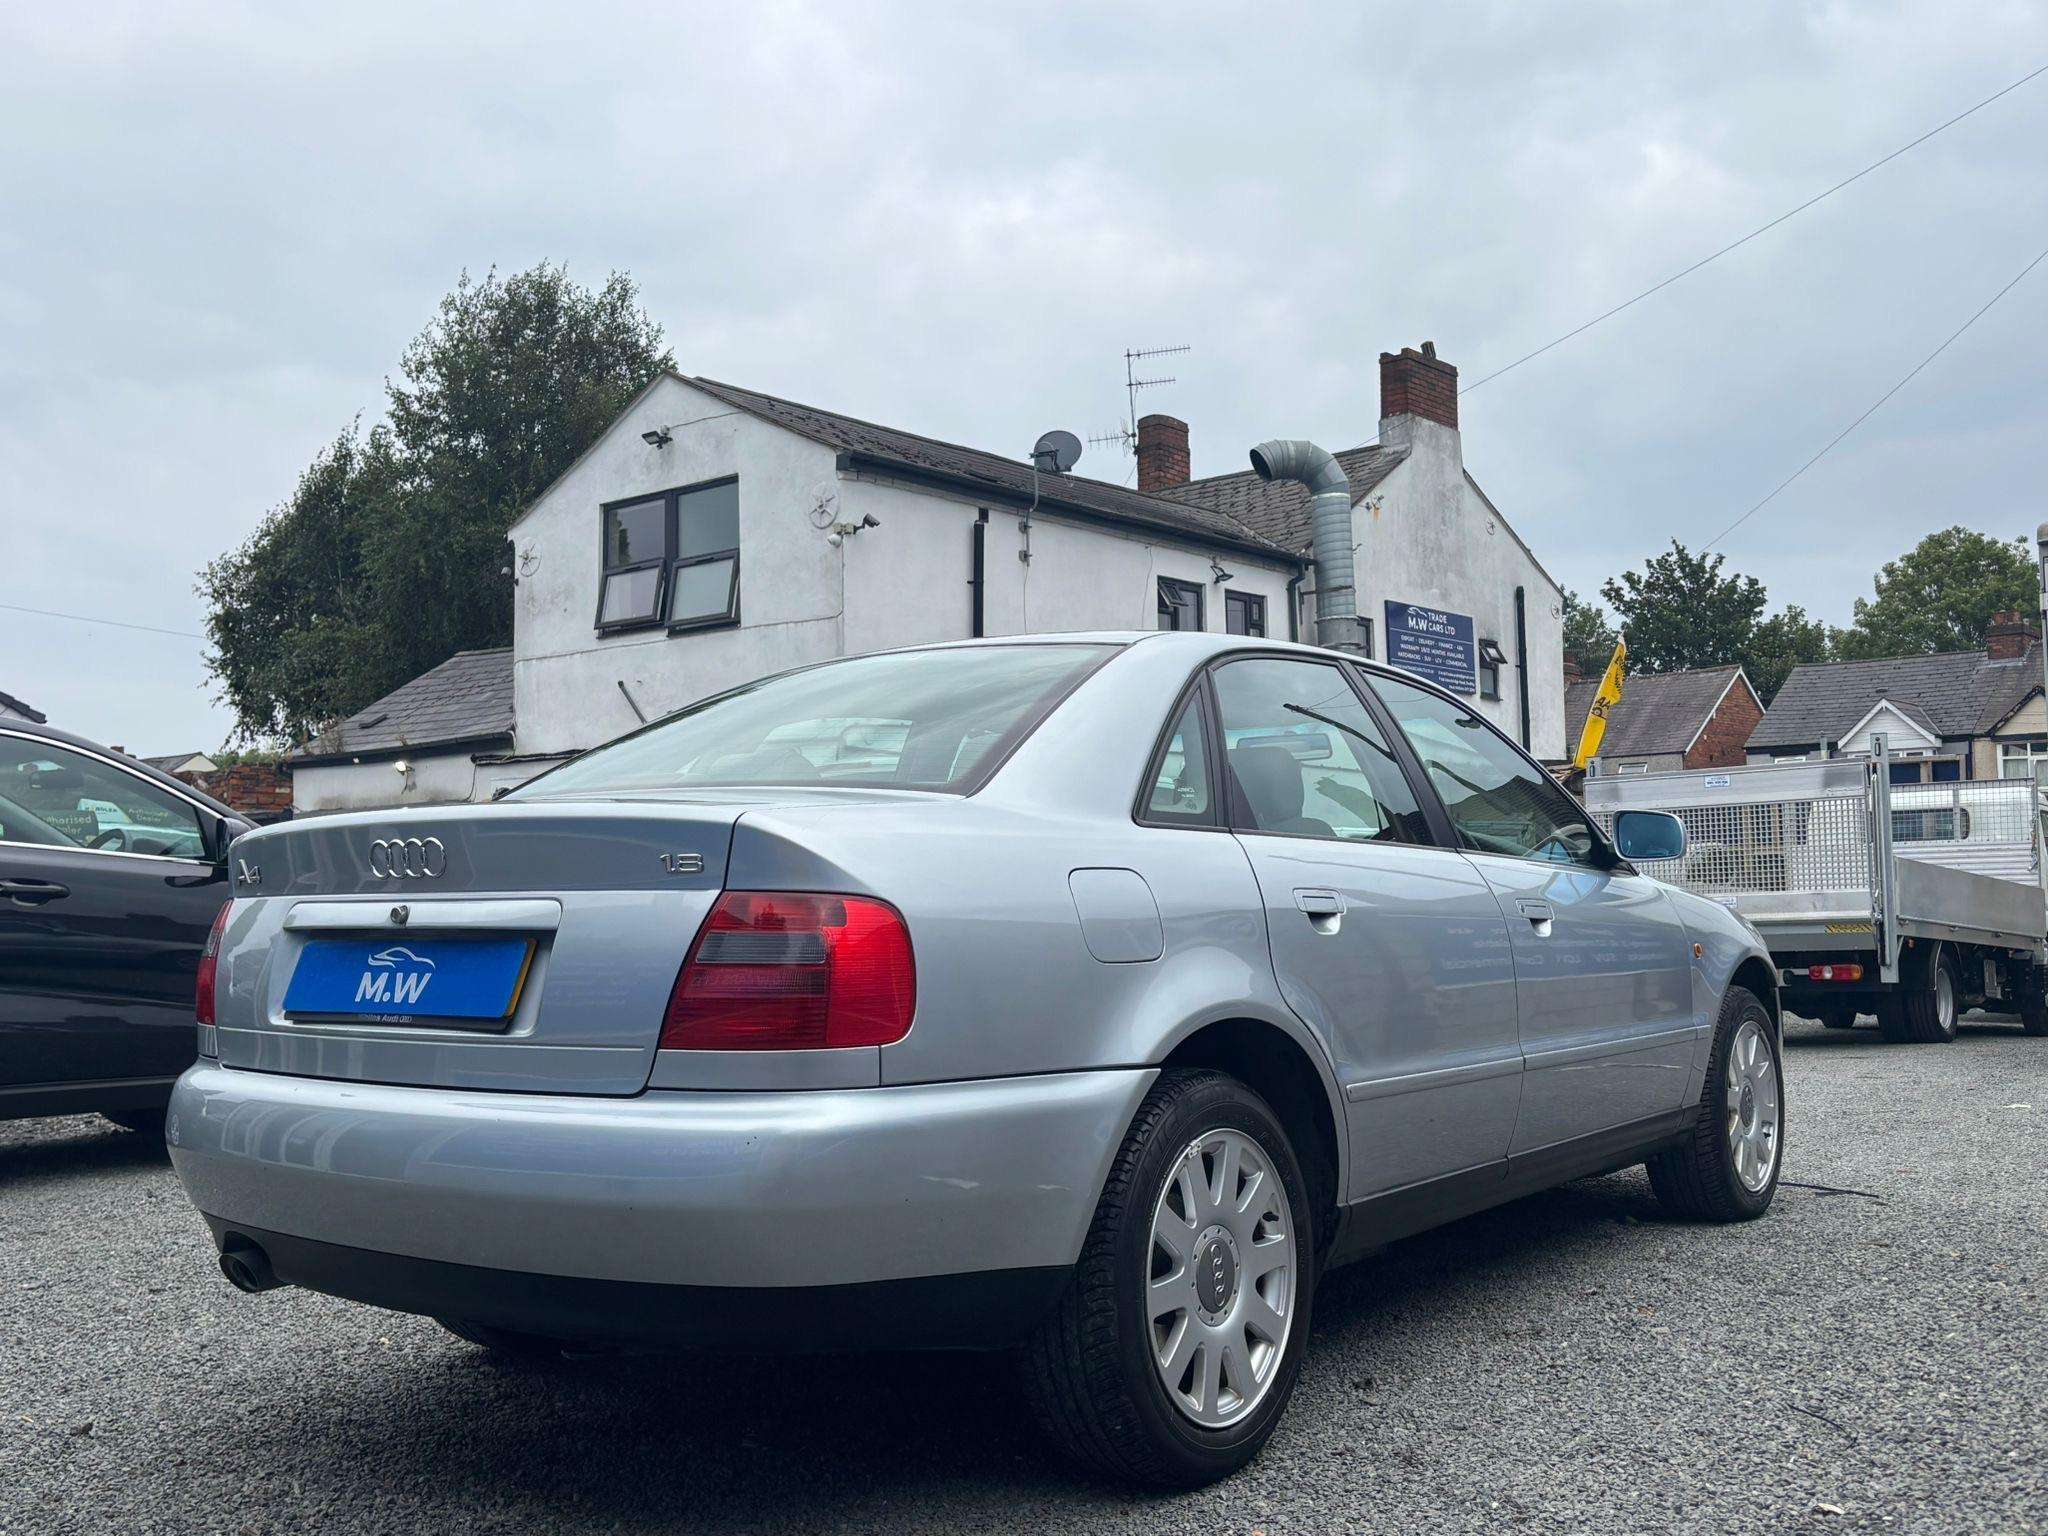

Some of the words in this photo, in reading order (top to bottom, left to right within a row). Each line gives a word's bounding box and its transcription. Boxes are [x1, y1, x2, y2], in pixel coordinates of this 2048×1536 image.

[1408, 617, 1427, 631] M.W
[1428, 622, 1443, 633] CARS
[1444, 625, 1455, 636] LTD
[1427, 612, 1447, 624] TRADE
[238, 859, 261, 884] A4
[660, 853, 703, 872] 1.8
[355, 972, 432, 1003] M.W
